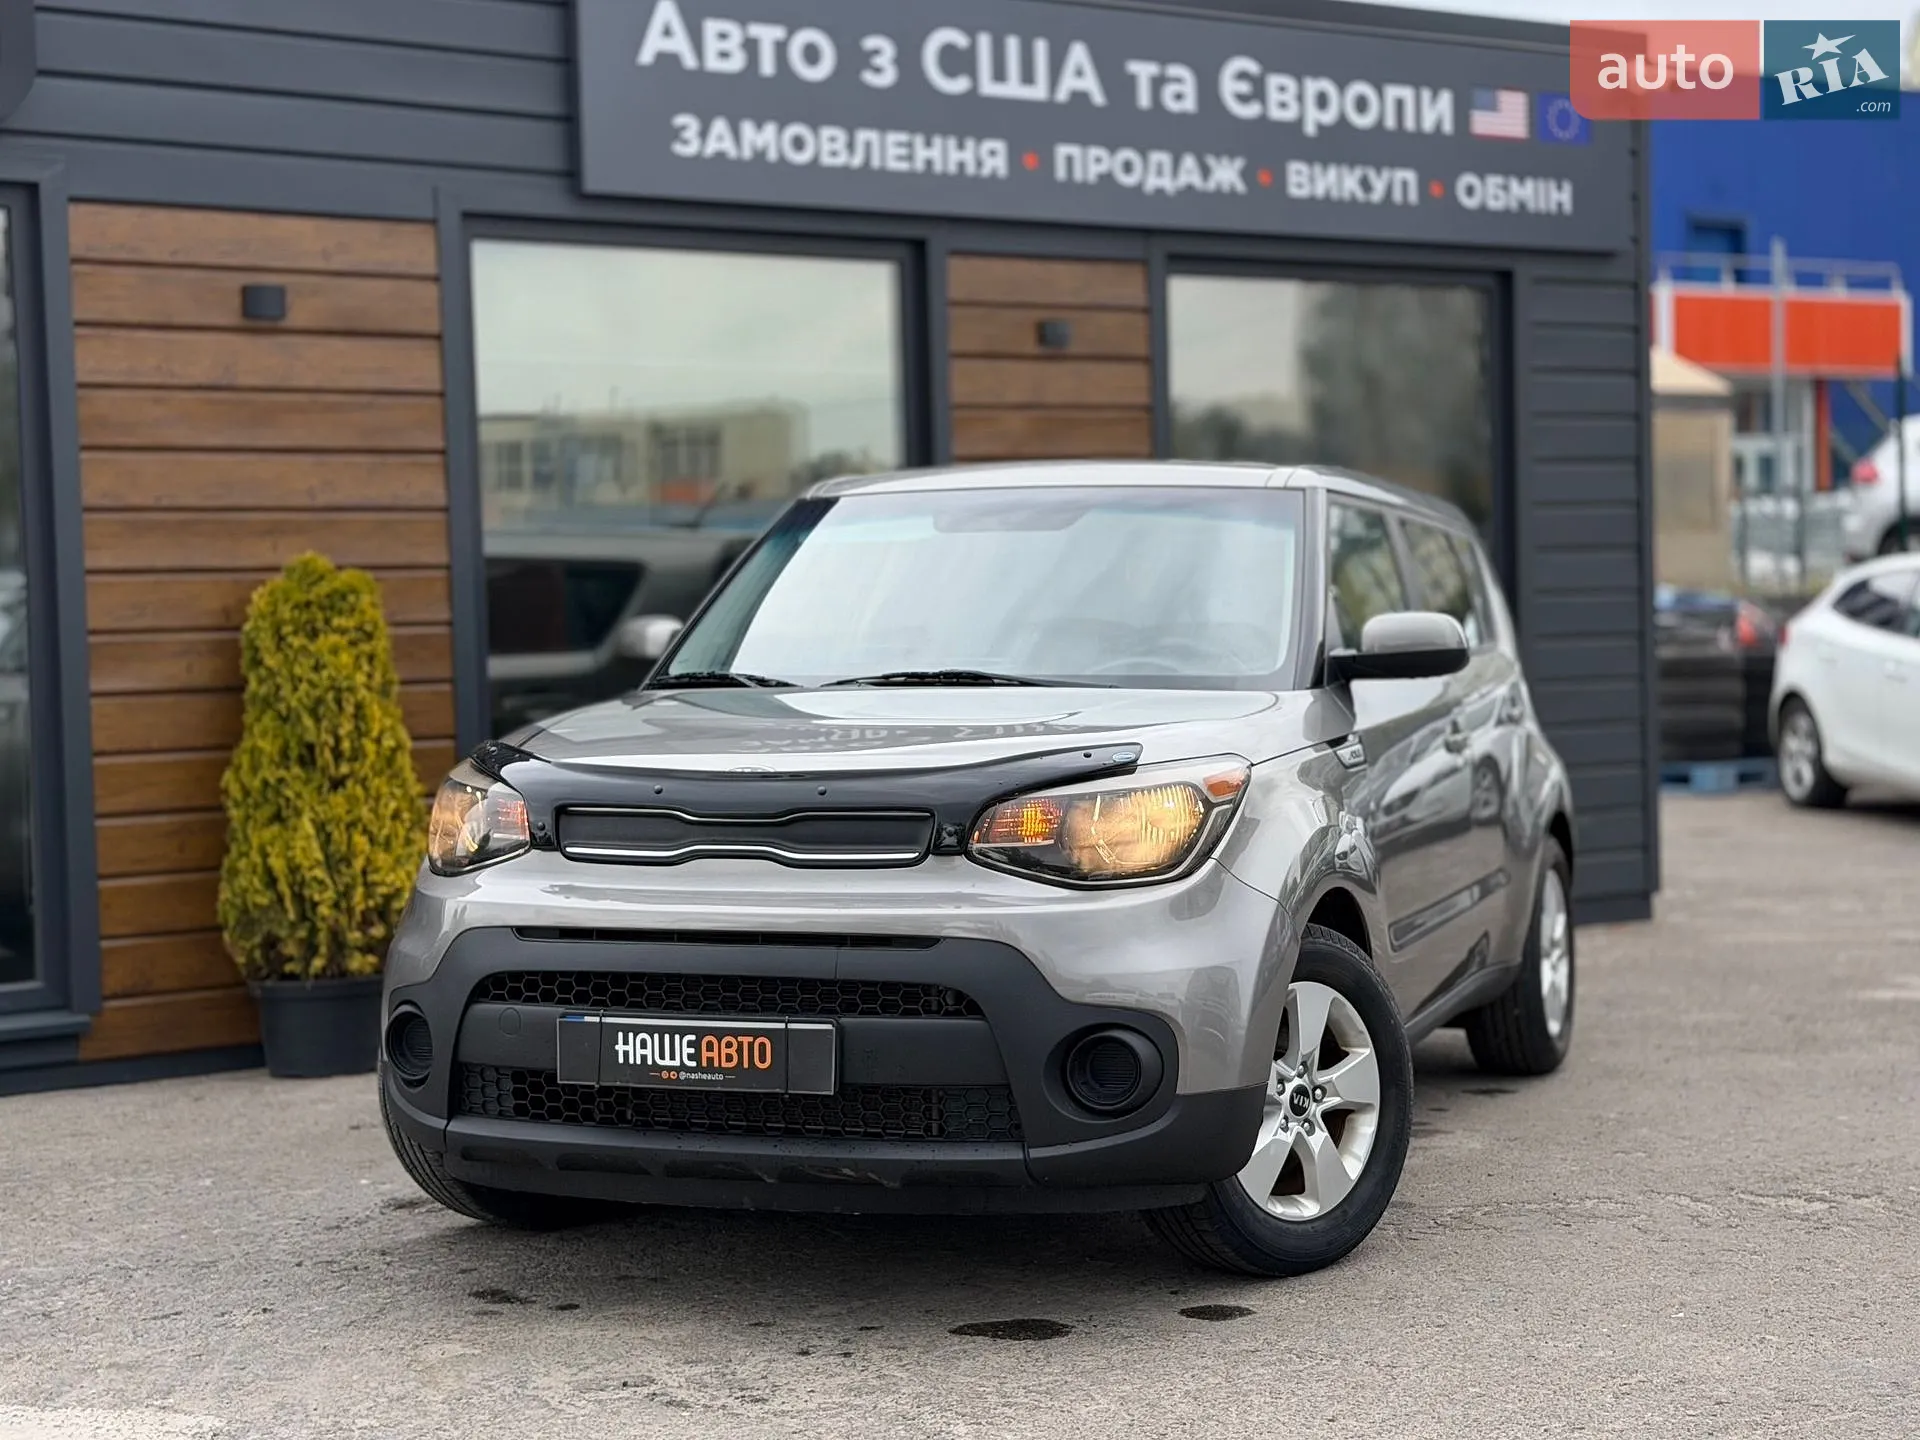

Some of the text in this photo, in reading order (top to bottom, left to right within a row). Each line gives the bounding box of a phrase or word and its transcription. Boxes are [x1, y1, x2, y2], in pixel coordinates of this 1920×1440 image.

[636, 0, 1455, 137] Авто з США та Європи
[670, 113, 1574, 216] ЗАМОВЛЕННЯ ПРОДАЖ ВИКУП ОБМІН
[679, 1071, 724, 1080] @nasheauto
[1293, 1092, 1310, 1108] KIA
